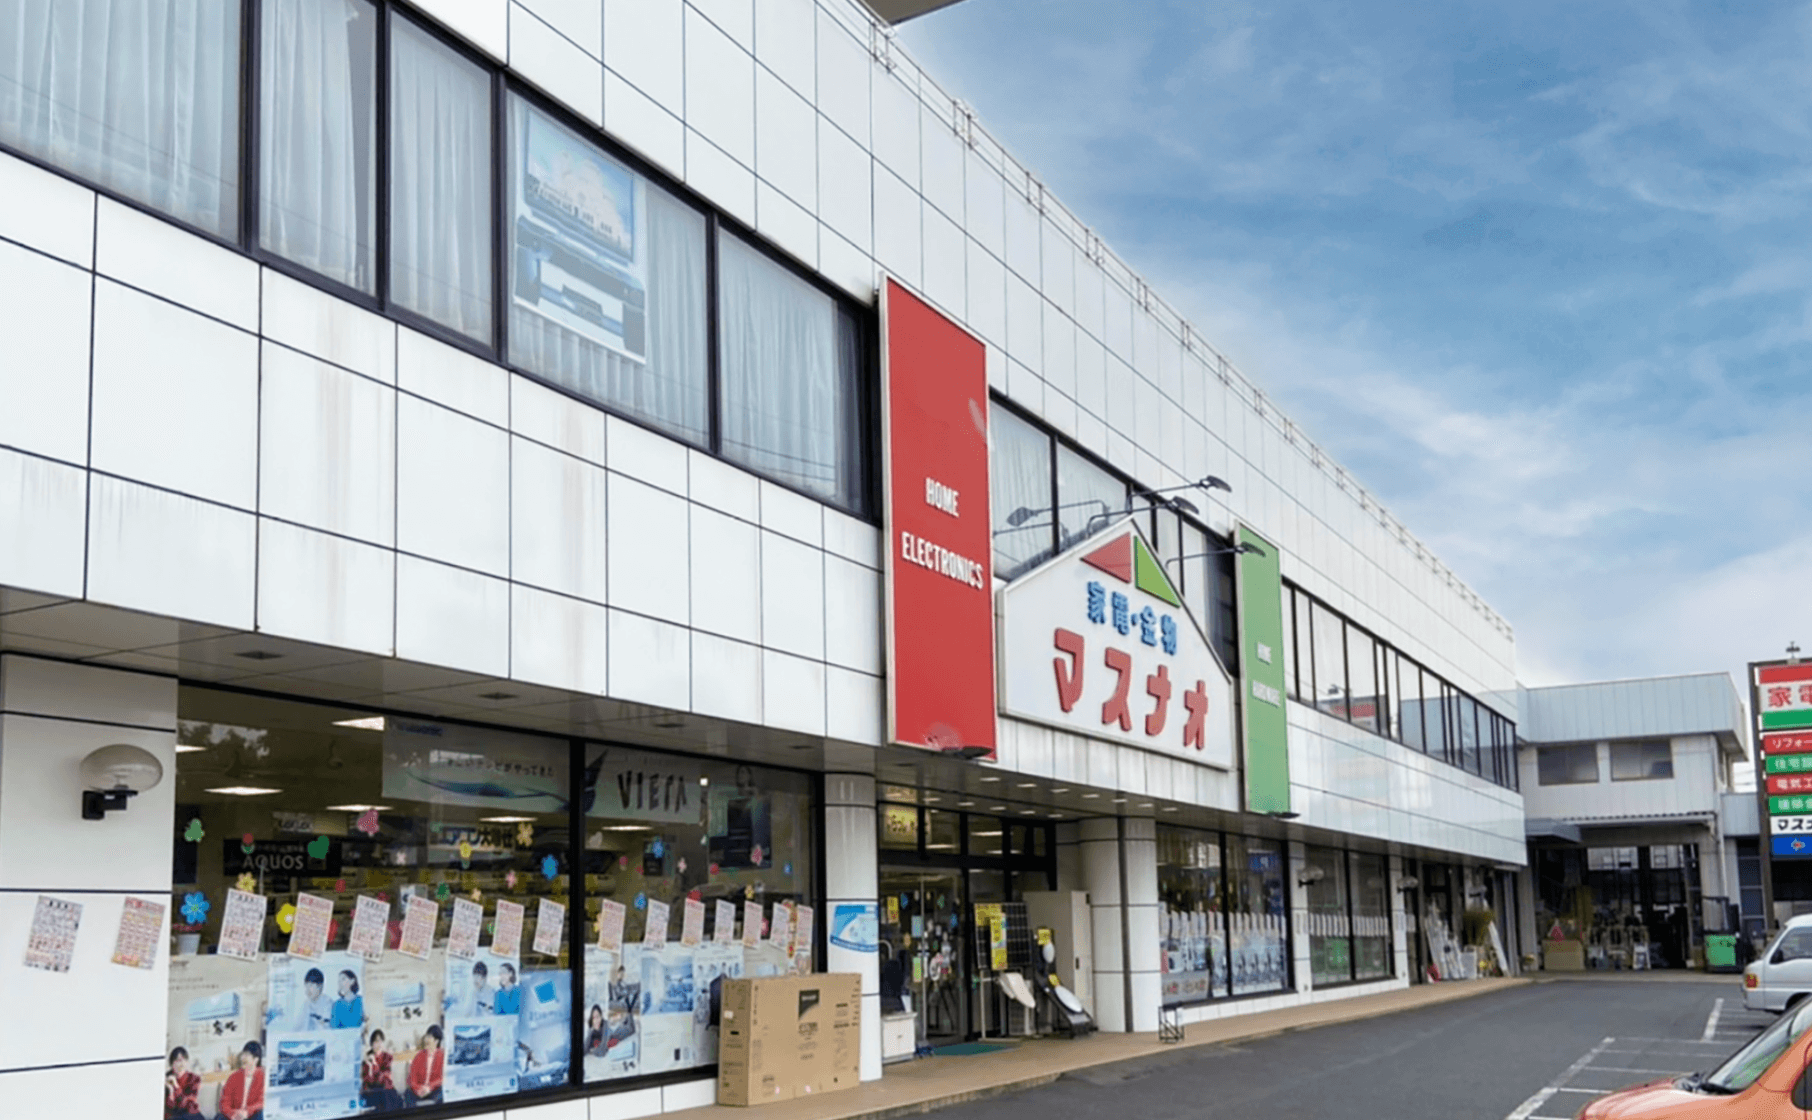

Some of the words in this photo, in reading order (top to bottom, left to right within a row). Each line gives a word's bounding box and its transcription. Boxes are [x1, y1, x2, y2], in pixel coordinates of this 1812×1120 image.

[925, 477, 960, 518] HOME
[901, 531, 984, 590] ELECTRONICS
[1053, 627, 1209, 750] マスナオ
[242, 854, 304, 872] AQUOS
